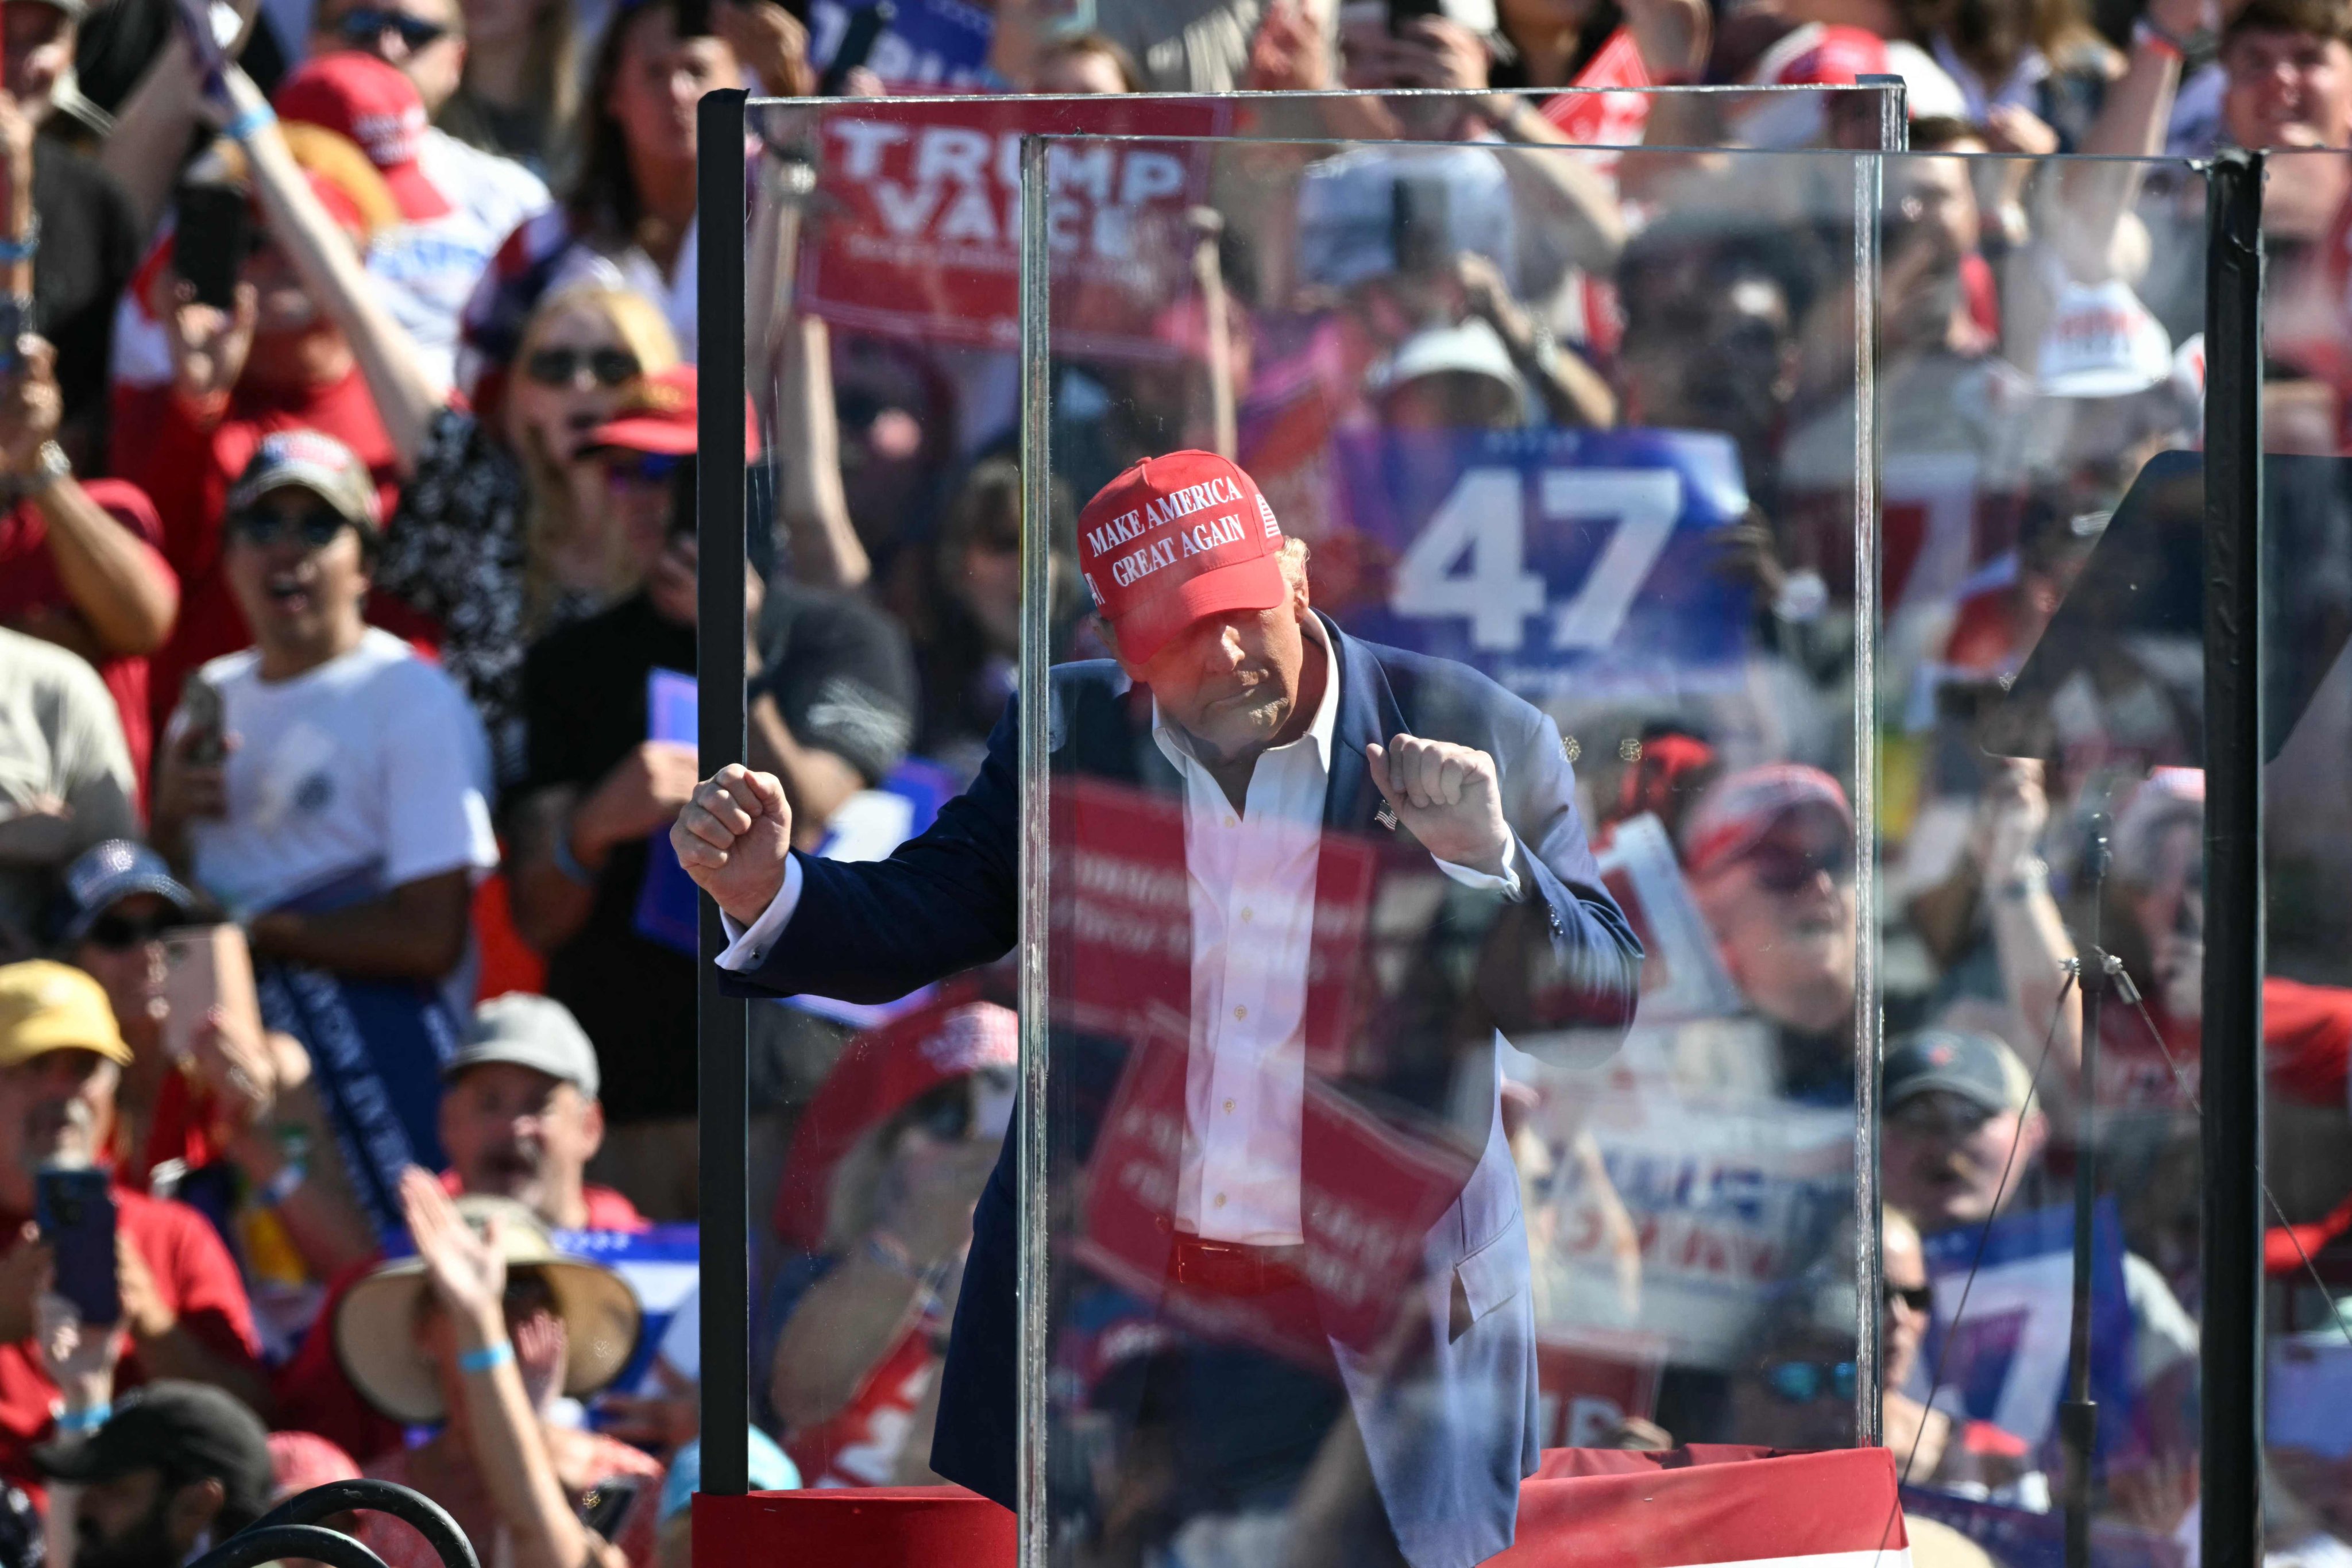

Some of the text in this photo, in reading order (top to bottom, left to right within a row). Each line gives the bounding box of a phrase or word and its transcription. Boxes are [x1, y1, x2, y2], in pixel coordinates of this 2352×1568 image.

[1086, 476, 1243, 558] MAKE AMERICA
[1112, 513, 1245, 587] GREAT AGAIN
[1390, 464, 1686, 652] 47
